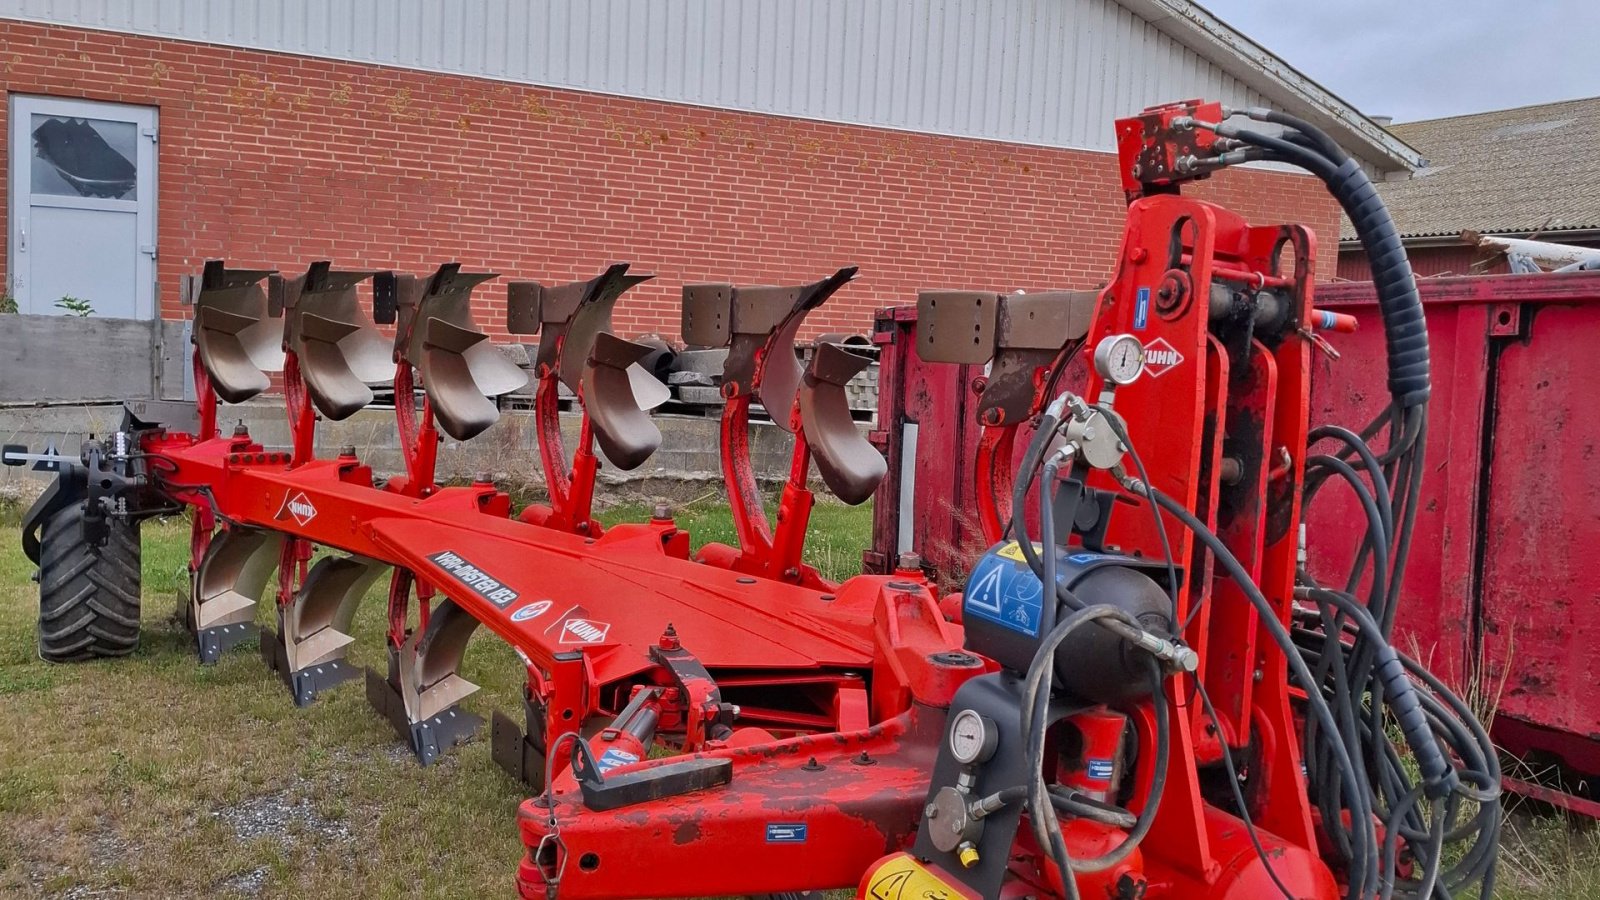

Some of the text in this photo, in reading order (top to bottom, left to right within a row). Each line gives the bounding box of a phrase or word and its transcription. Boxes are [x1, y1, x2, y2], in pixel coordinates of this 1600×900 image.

[291, 501, 313, 517] KUHN
[434, 551, 518, 604] VARI-MASTER 183
[565, 619, 605, 643] KUHN
